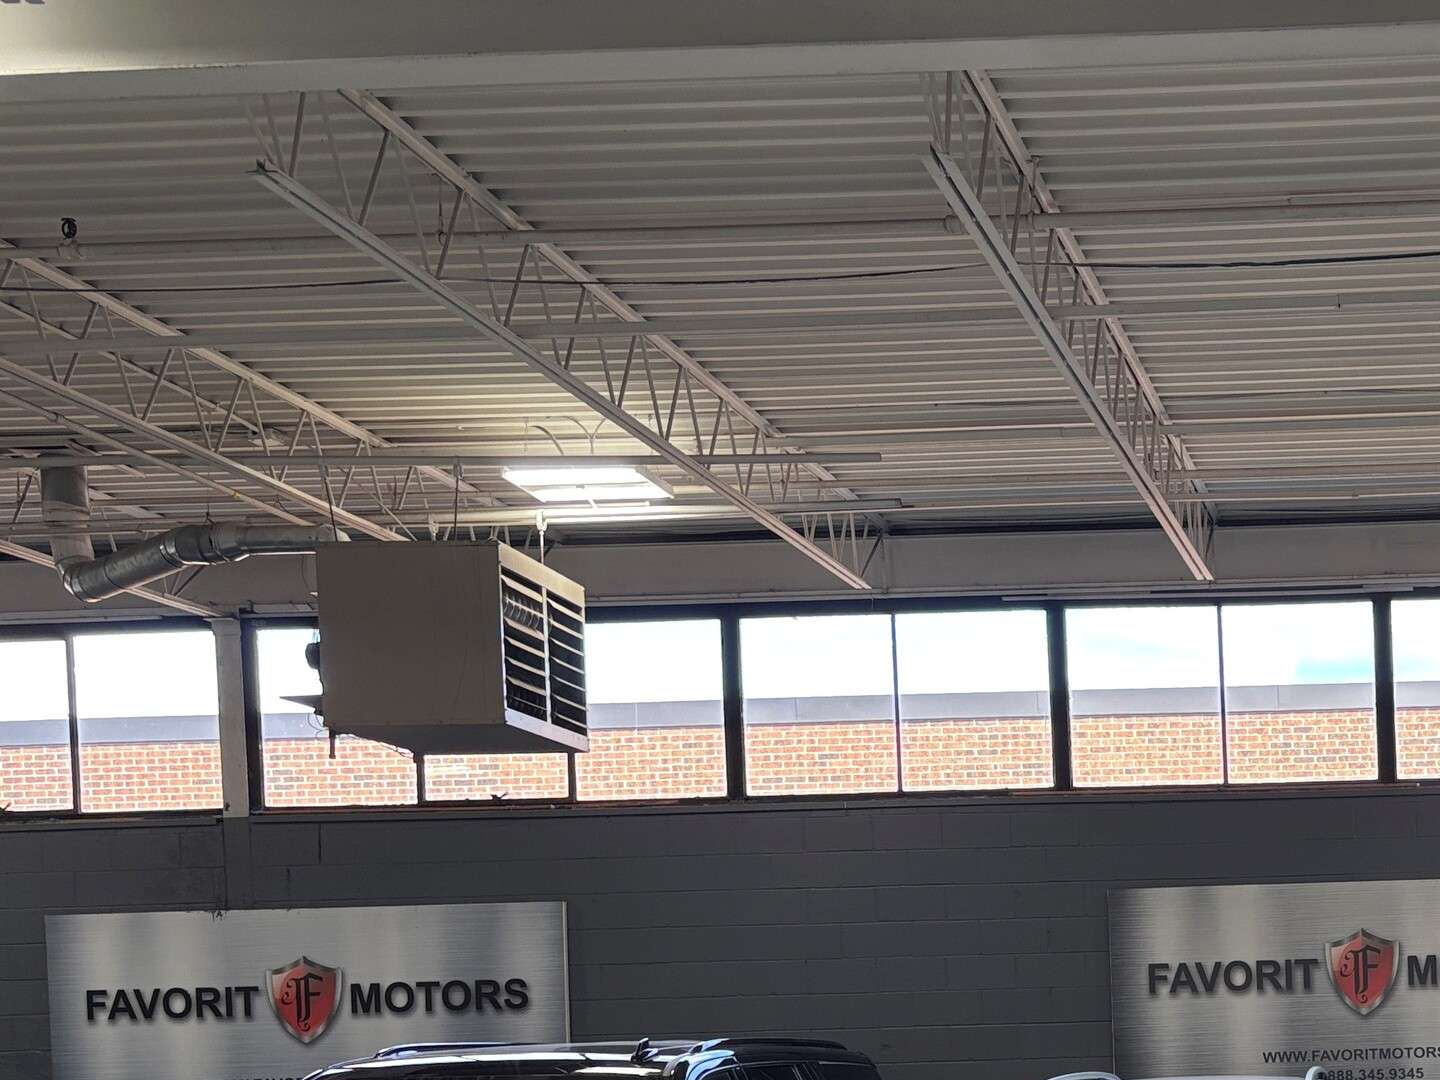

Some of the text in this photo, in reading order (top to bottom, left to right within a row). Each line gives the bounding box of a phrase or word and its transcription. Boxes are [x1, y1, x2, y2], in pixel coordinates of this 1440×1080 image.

[1148, 958, 1319, 994] FAVORIT
[86, 978, 530, 1021] FAVORIT MOTORS
